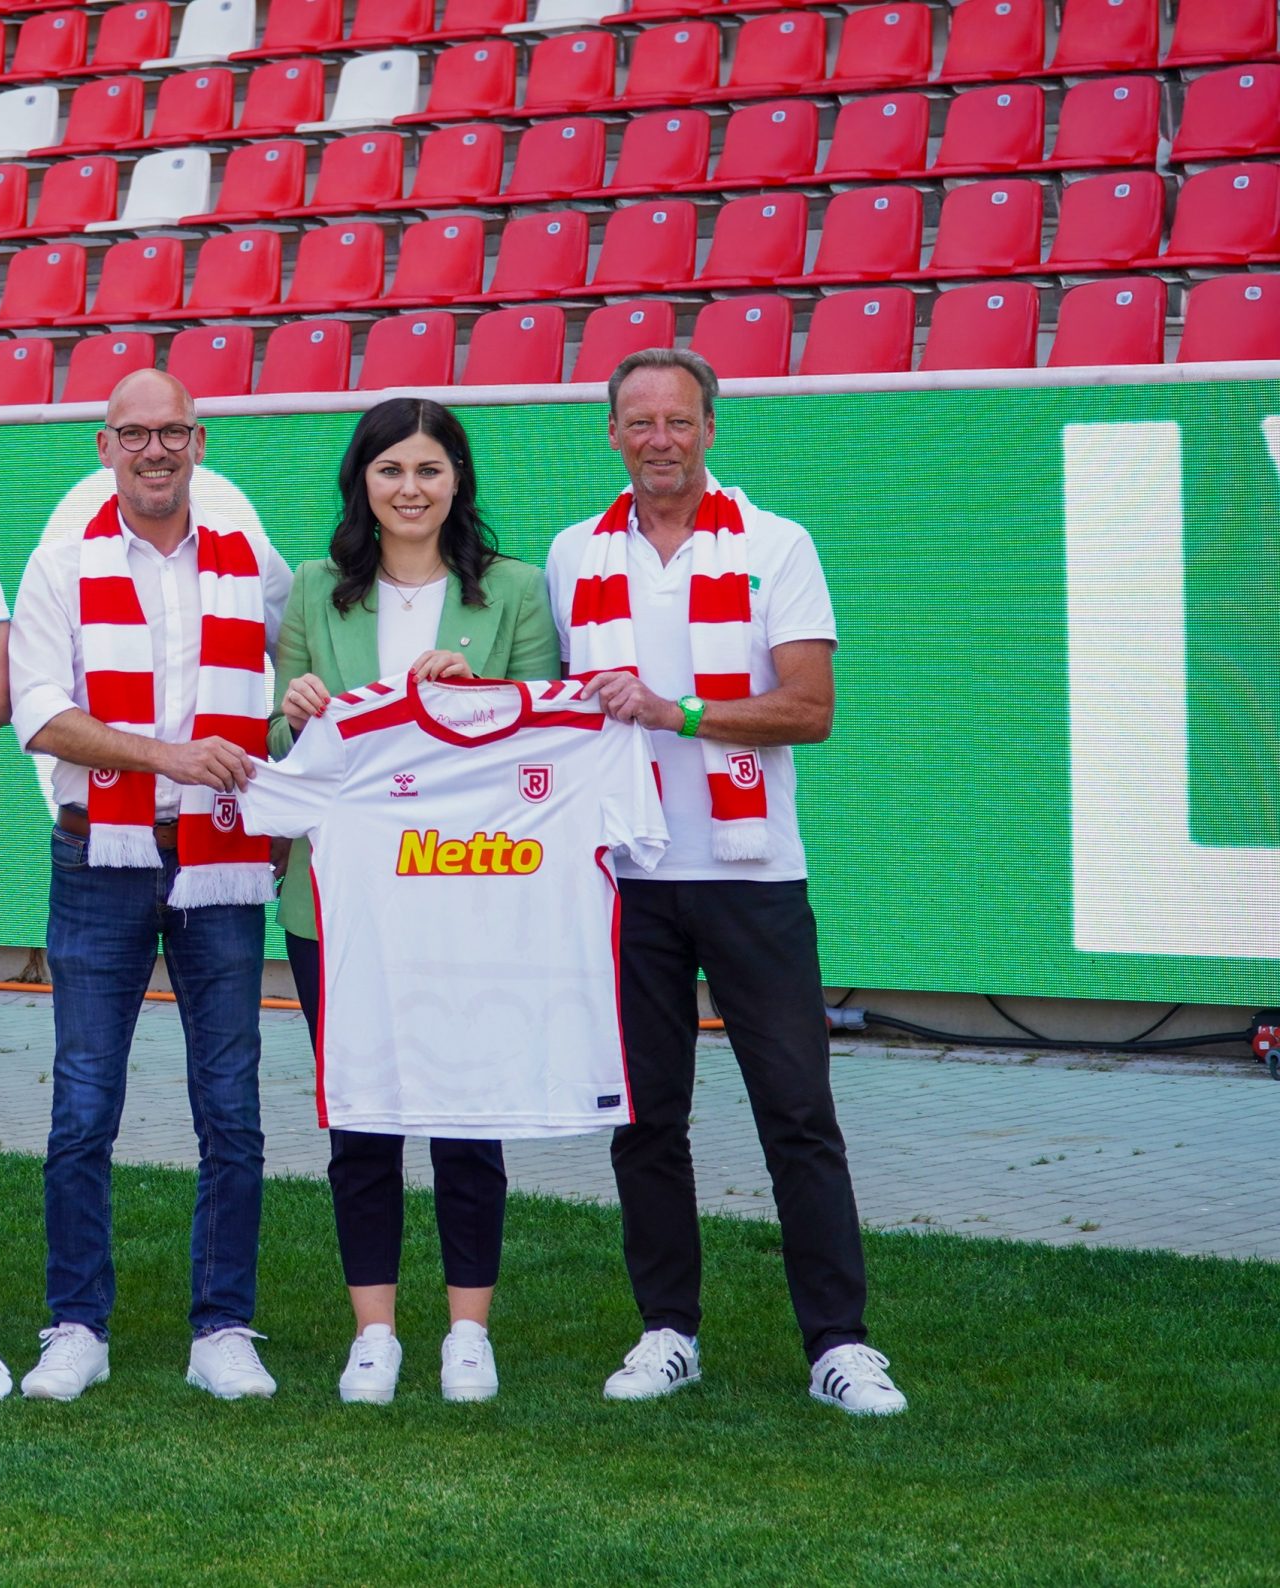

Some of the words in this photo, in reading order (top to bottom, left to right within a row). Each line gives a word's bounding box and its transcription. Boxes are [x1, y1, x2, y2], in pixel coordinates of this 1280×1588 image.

[1063, 415, 1280, 959] L
[389, 789, 419, 798] hummel
[397, 830, 542, 875] Netto
